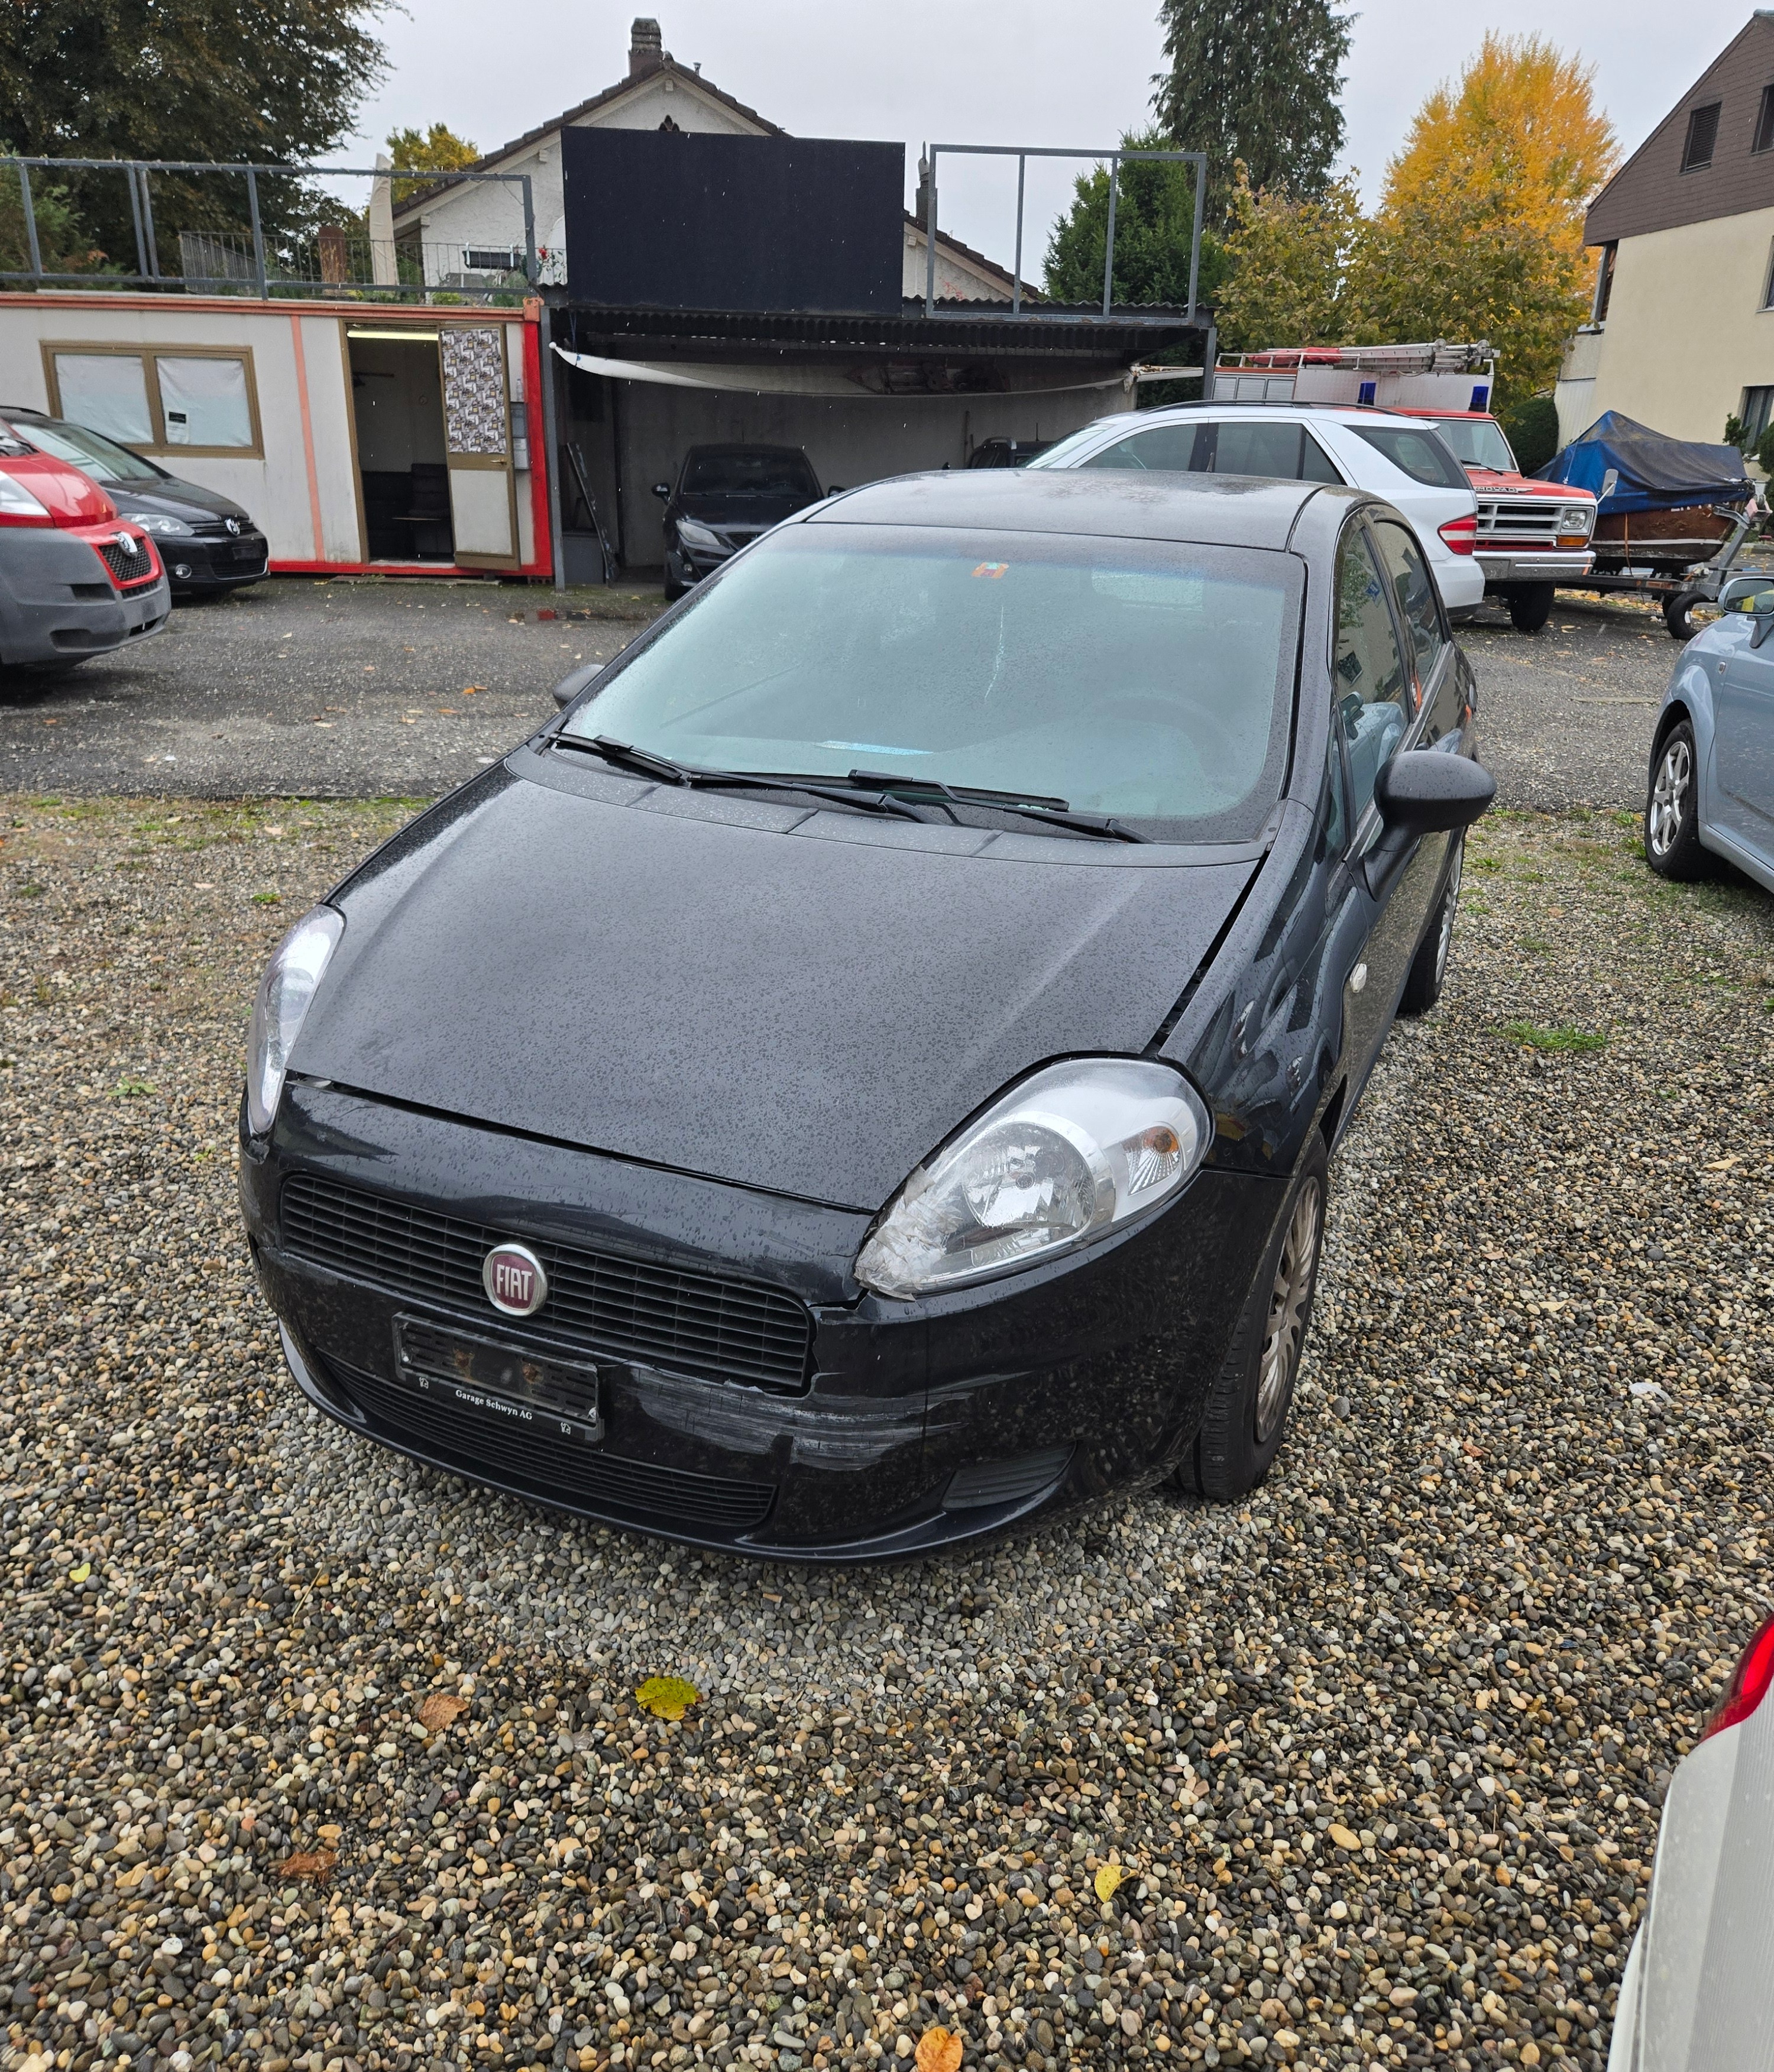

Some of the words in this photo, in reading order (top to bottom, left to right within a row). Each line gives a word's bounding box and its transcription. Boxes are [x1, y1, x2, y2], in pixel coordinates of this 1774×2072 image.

[497, 1264, 532, 1301] FIAT
[455, 1390, 484, 1405] Garage
[486, 1398, 518, 1415] Schwyn
[519, 1410, 532, 1420] AG
